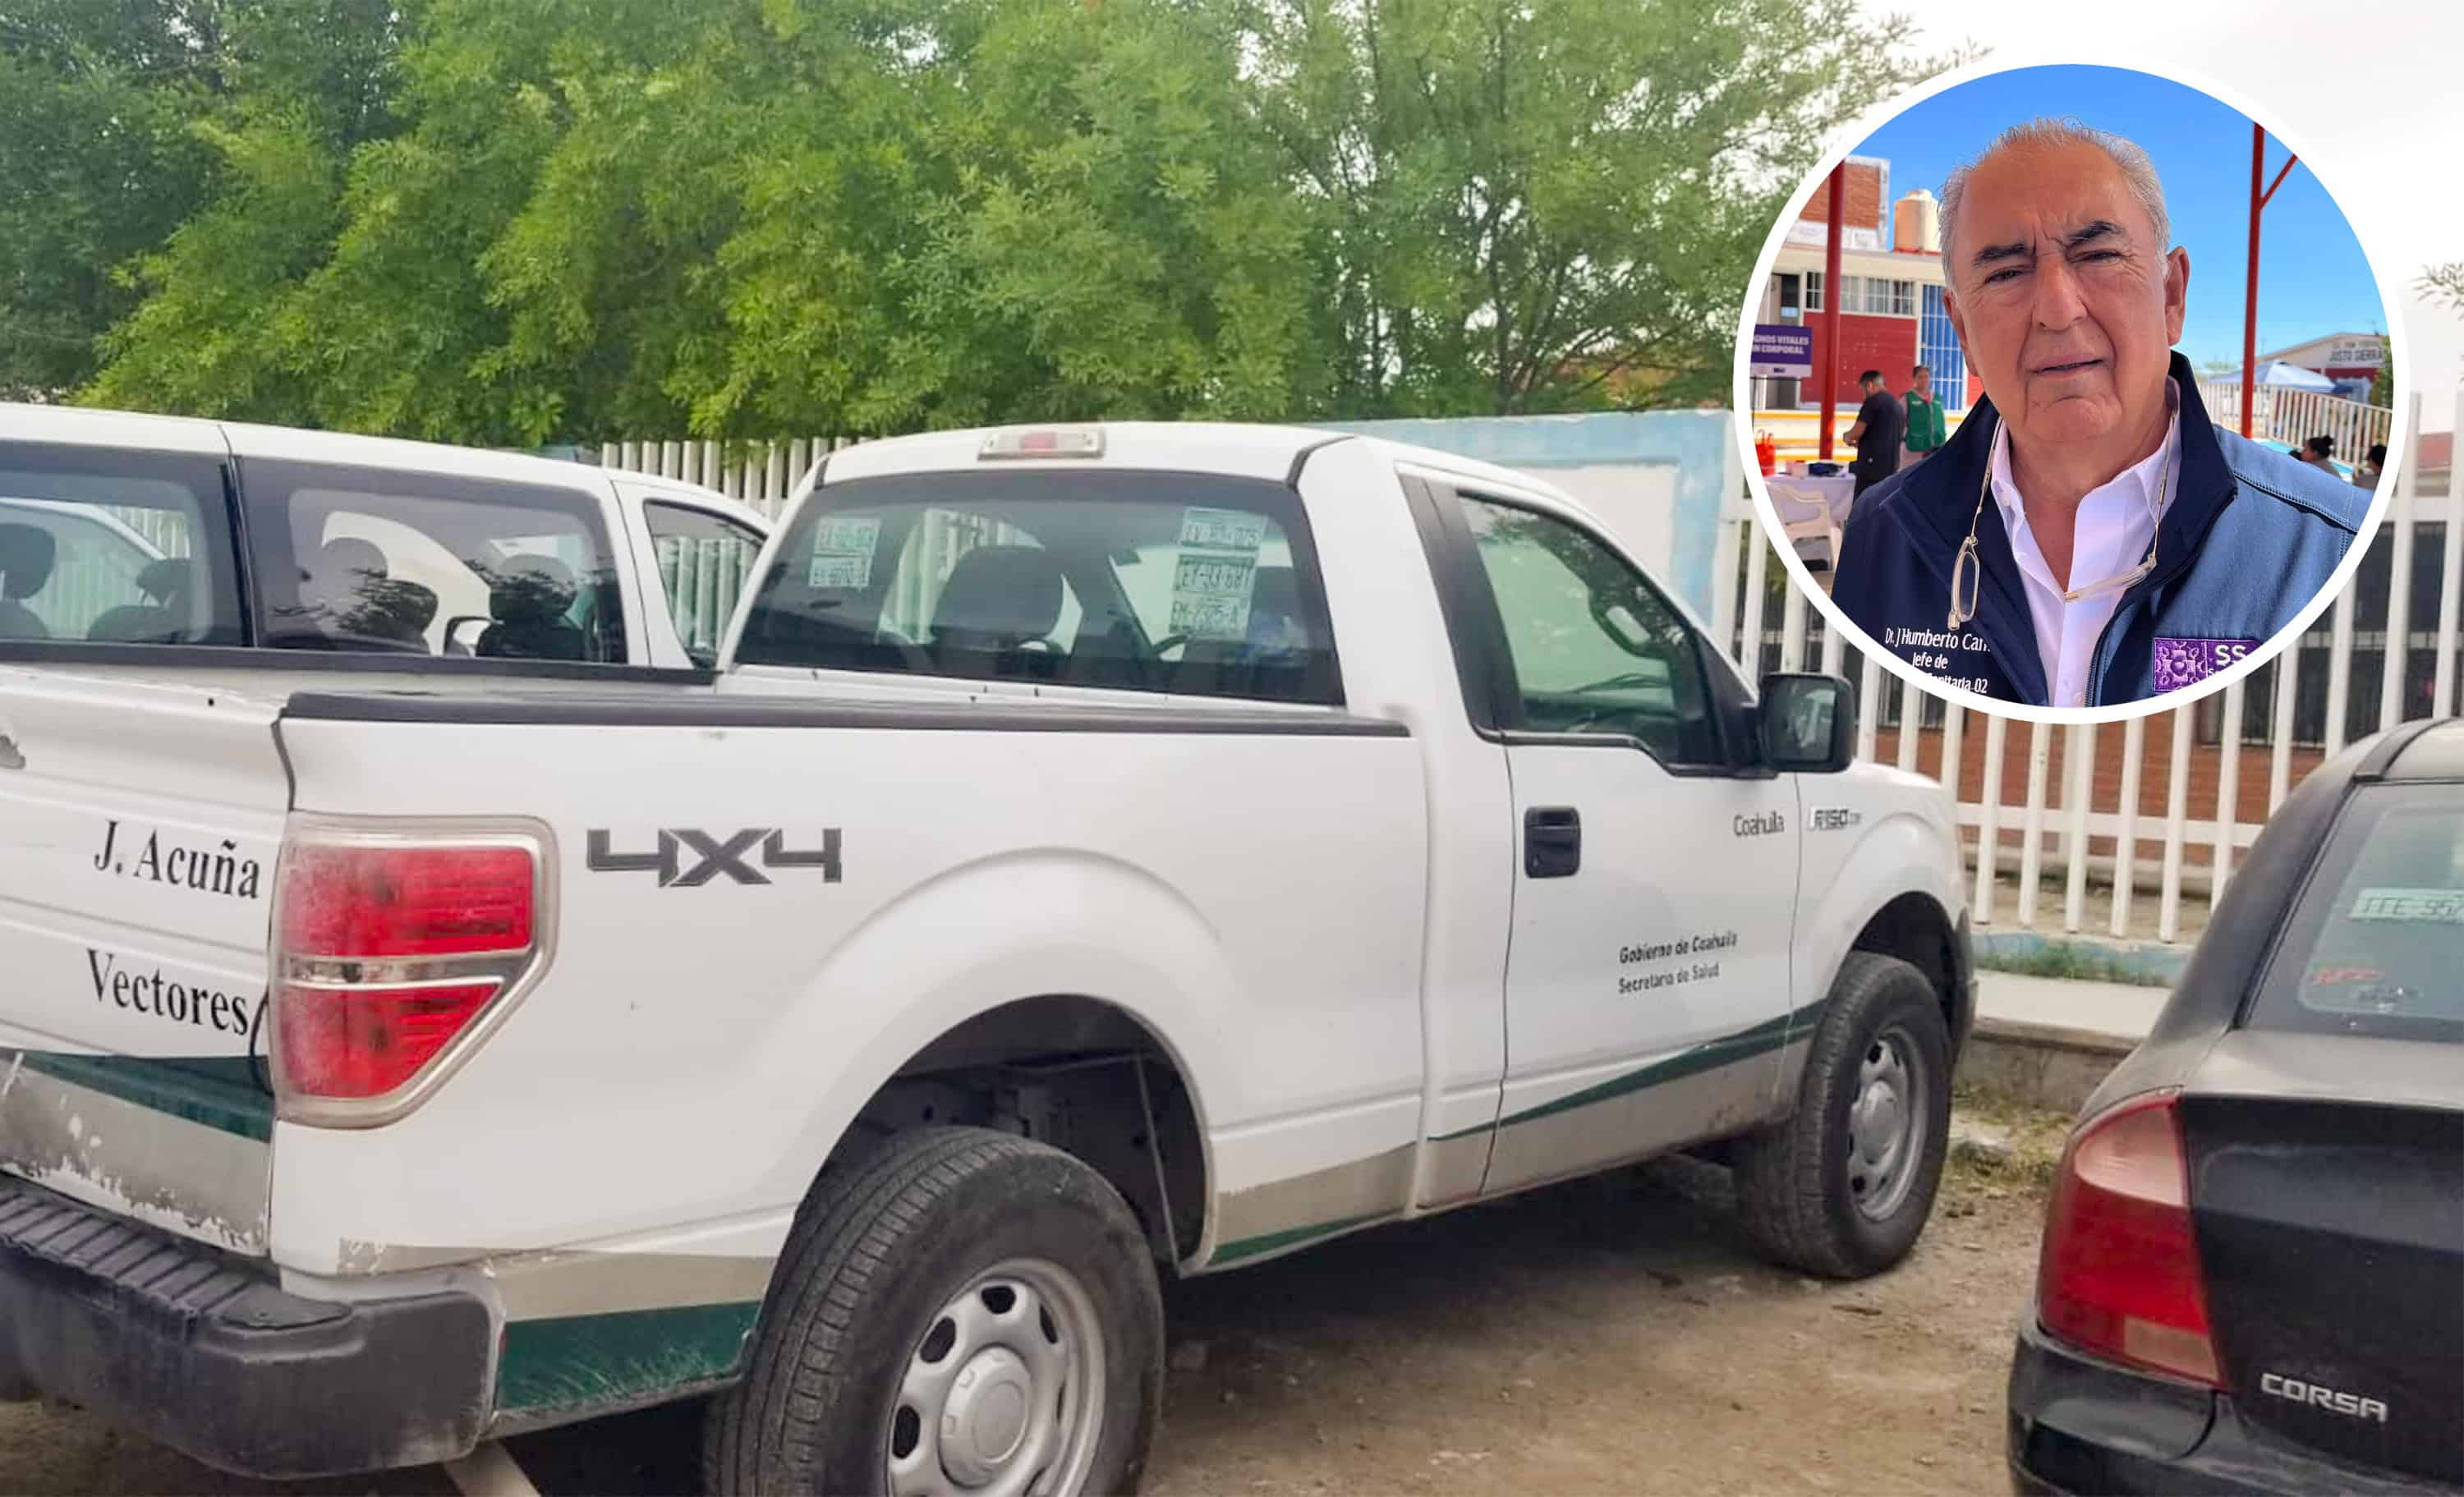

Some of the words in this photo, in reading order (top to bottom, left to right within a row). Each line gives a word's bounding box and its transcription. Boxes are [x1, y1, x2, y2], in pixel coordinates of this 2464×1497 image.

[1901, 628, 1959, 649] Humberto
[1934, 653, 1948, 669] de
[1974, 677, 1988, 694] 02
[1733, 810, 1785, 837] Coahuila
[93, 820, 122, 875] J.
[133, 828, 260, 899] Acuña
[1619, 943, 1673, 964] Gobierno
[1676, 940, 1689, 955] de
[1692, 930, 1738, 953] Coahuila
[1676, 968, 1689, 984] de
[1692, 962, 1720, 980] Salud
[86, 948, 249, 1036] Vectores
[2260, 1372, 2388, 1423] CORSA
